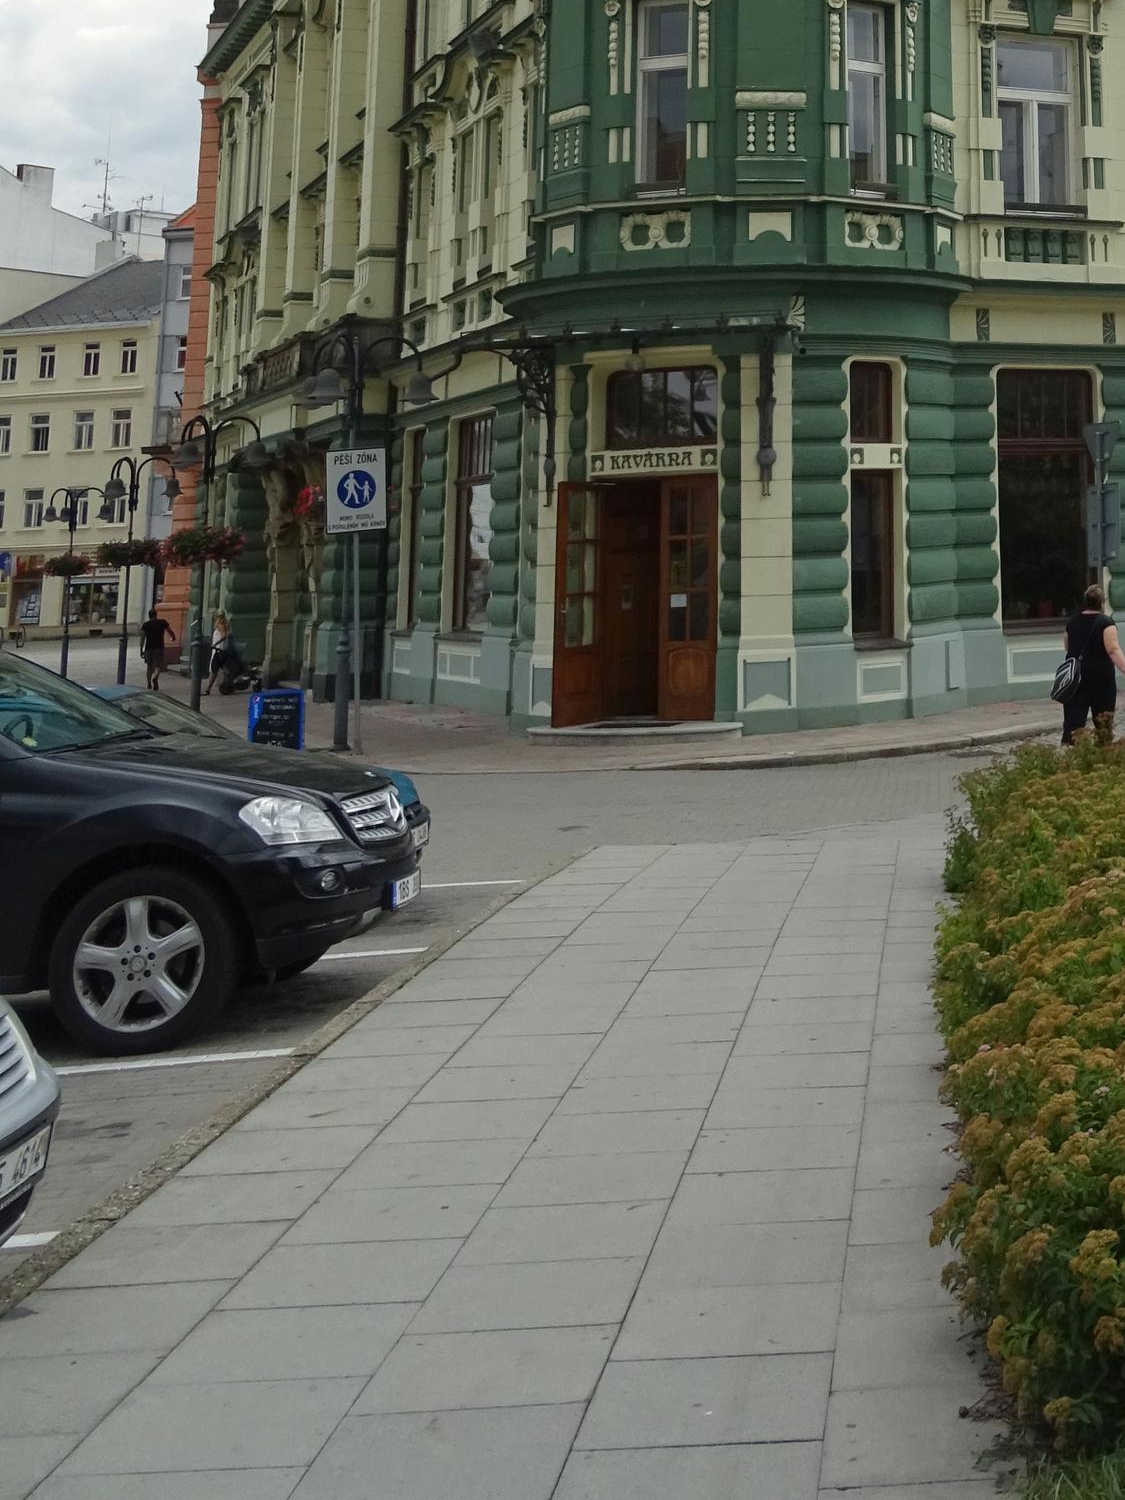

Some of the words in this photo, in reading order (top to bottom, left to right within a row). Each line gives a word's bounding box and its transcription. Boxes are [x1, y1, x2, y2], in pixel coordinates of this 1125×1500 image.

[334, 453, 353, 466] PĚŠÍ
[356, 452, 378, 465] ZÓNA
[610, 451, 693, 470] KAVÁRNA
